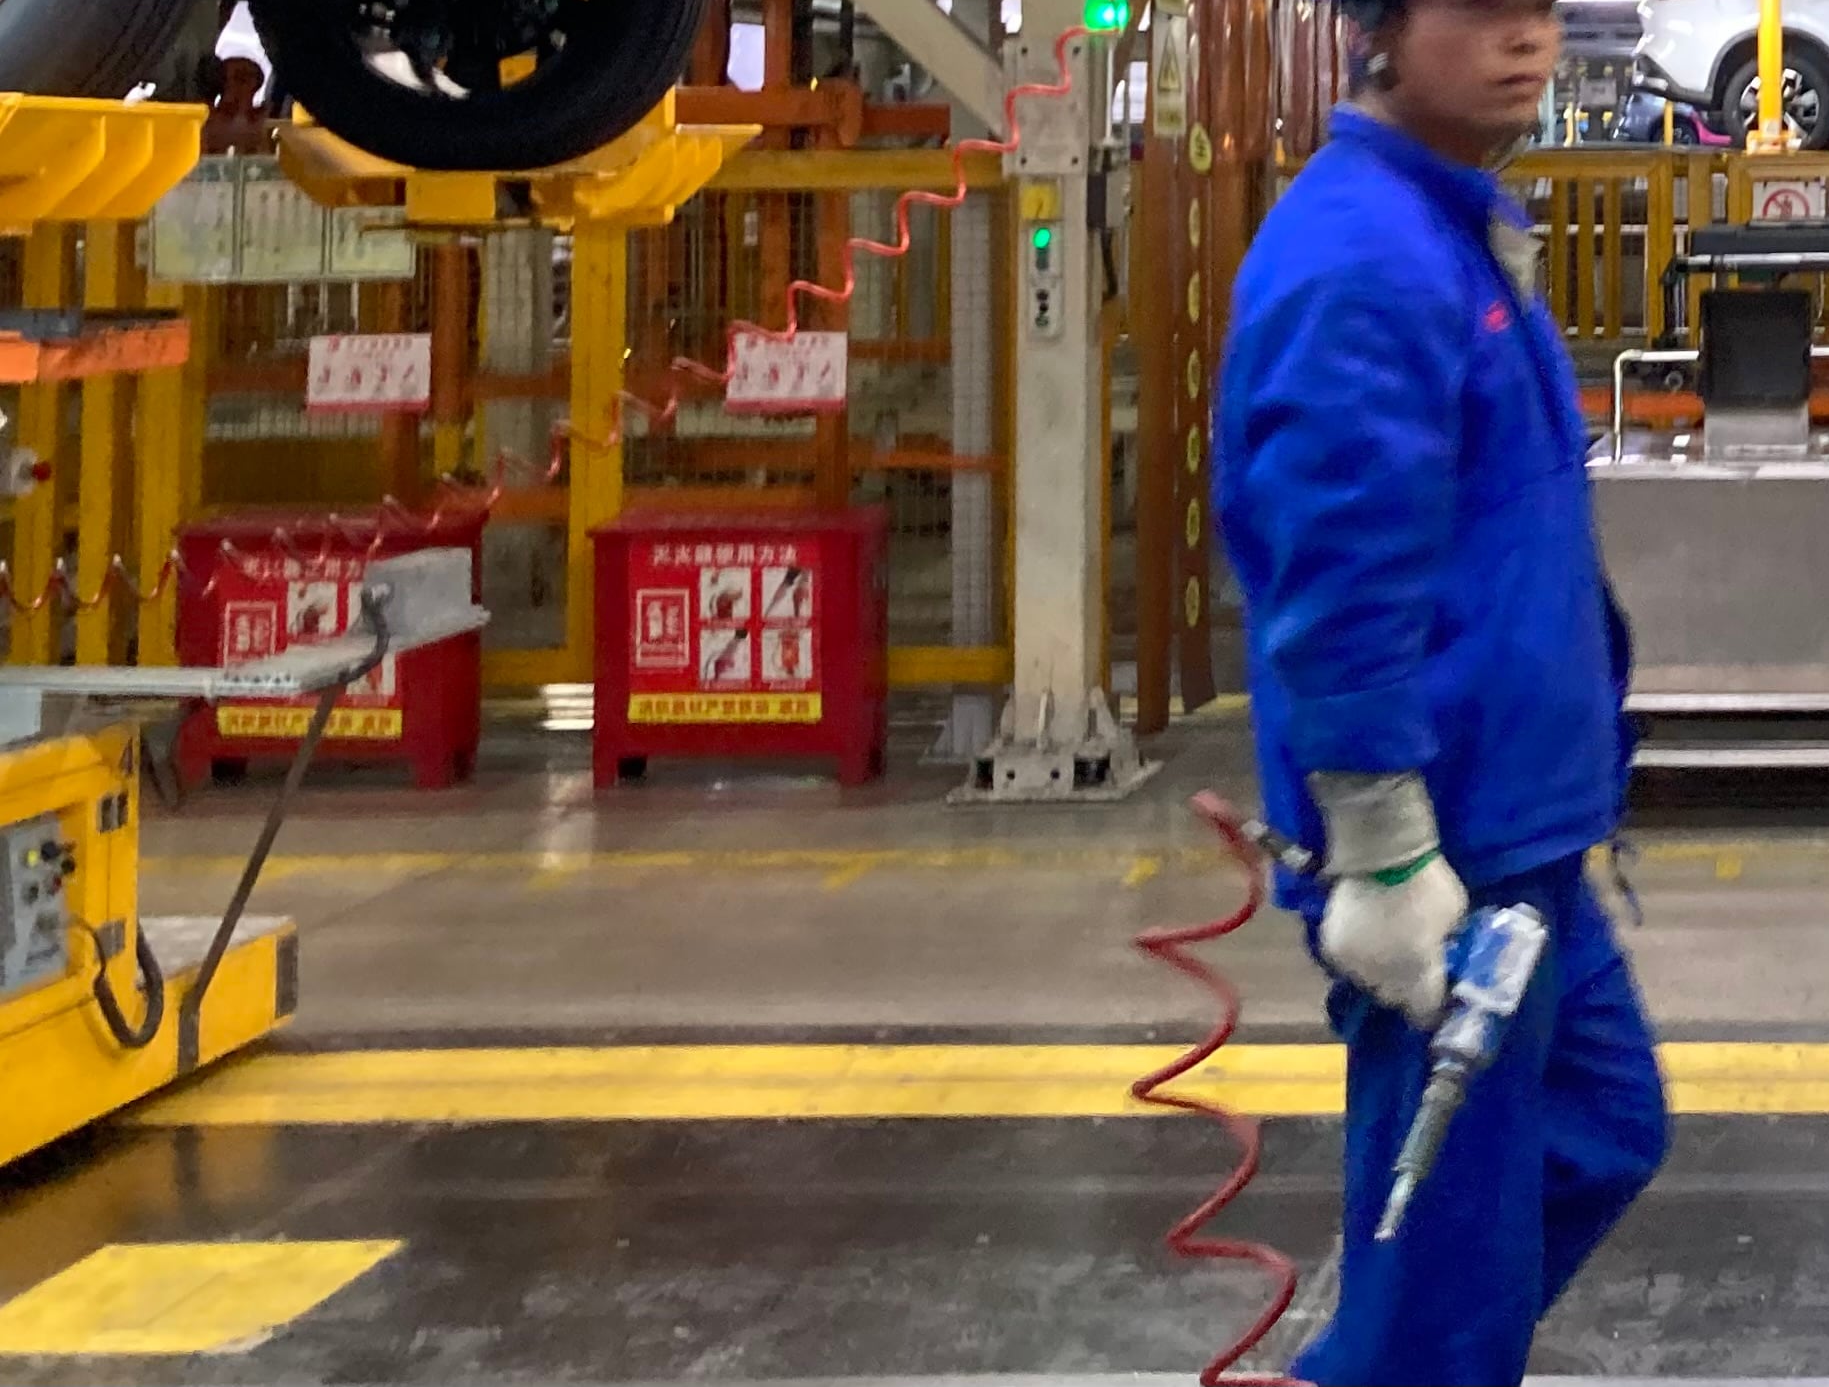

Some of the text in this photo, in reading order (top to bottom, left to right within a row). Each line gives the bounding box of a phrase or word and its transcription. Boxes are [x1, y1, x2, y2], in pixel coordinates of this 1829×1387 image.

[652, 542, 799, 566] 灭火器使用方法
